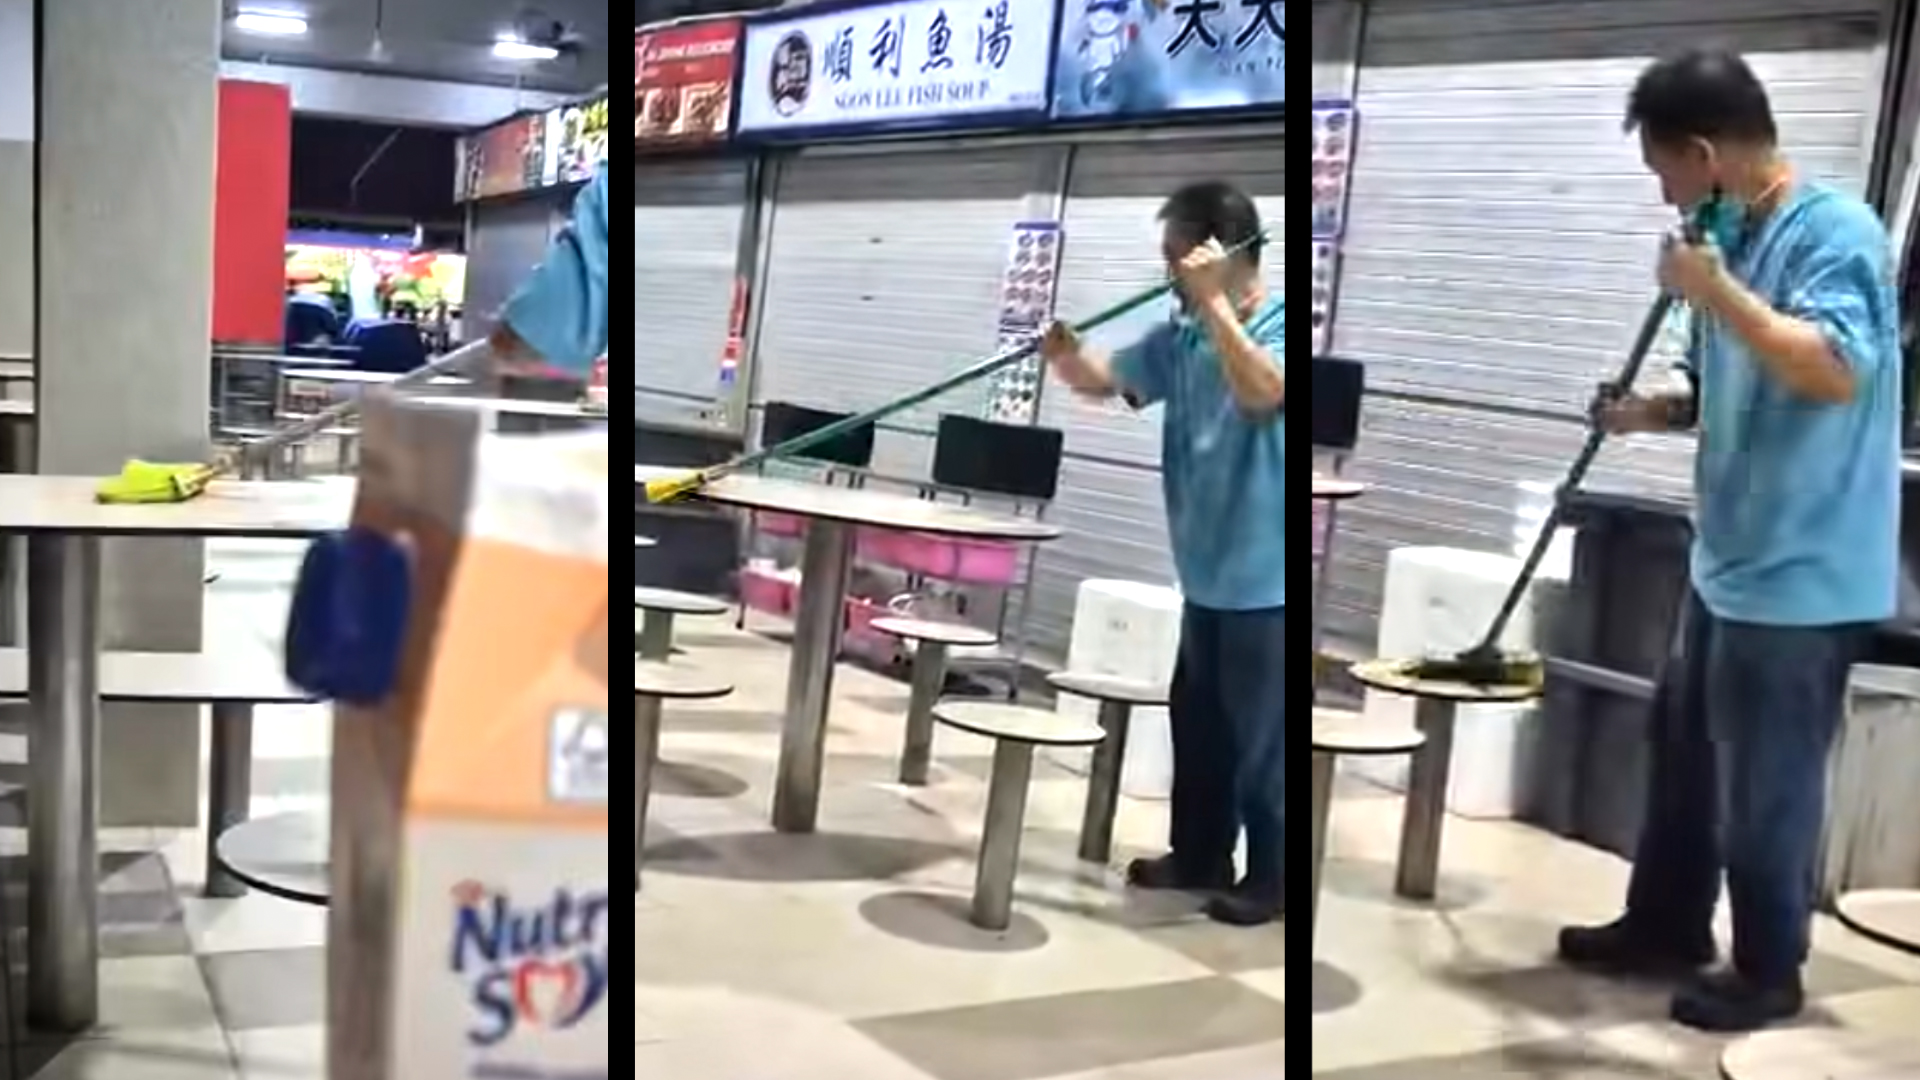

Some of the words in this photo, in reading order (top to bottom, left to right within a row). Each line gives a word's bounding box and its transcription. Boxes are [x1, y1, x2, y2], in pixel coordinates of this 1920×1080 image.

[822, 1, 1013, 83] 順利魚湯
[875, 86, 902, 108] LEE
[907, 82, 944, 106] FISH
[946, 79, 990, 101] SOUP
